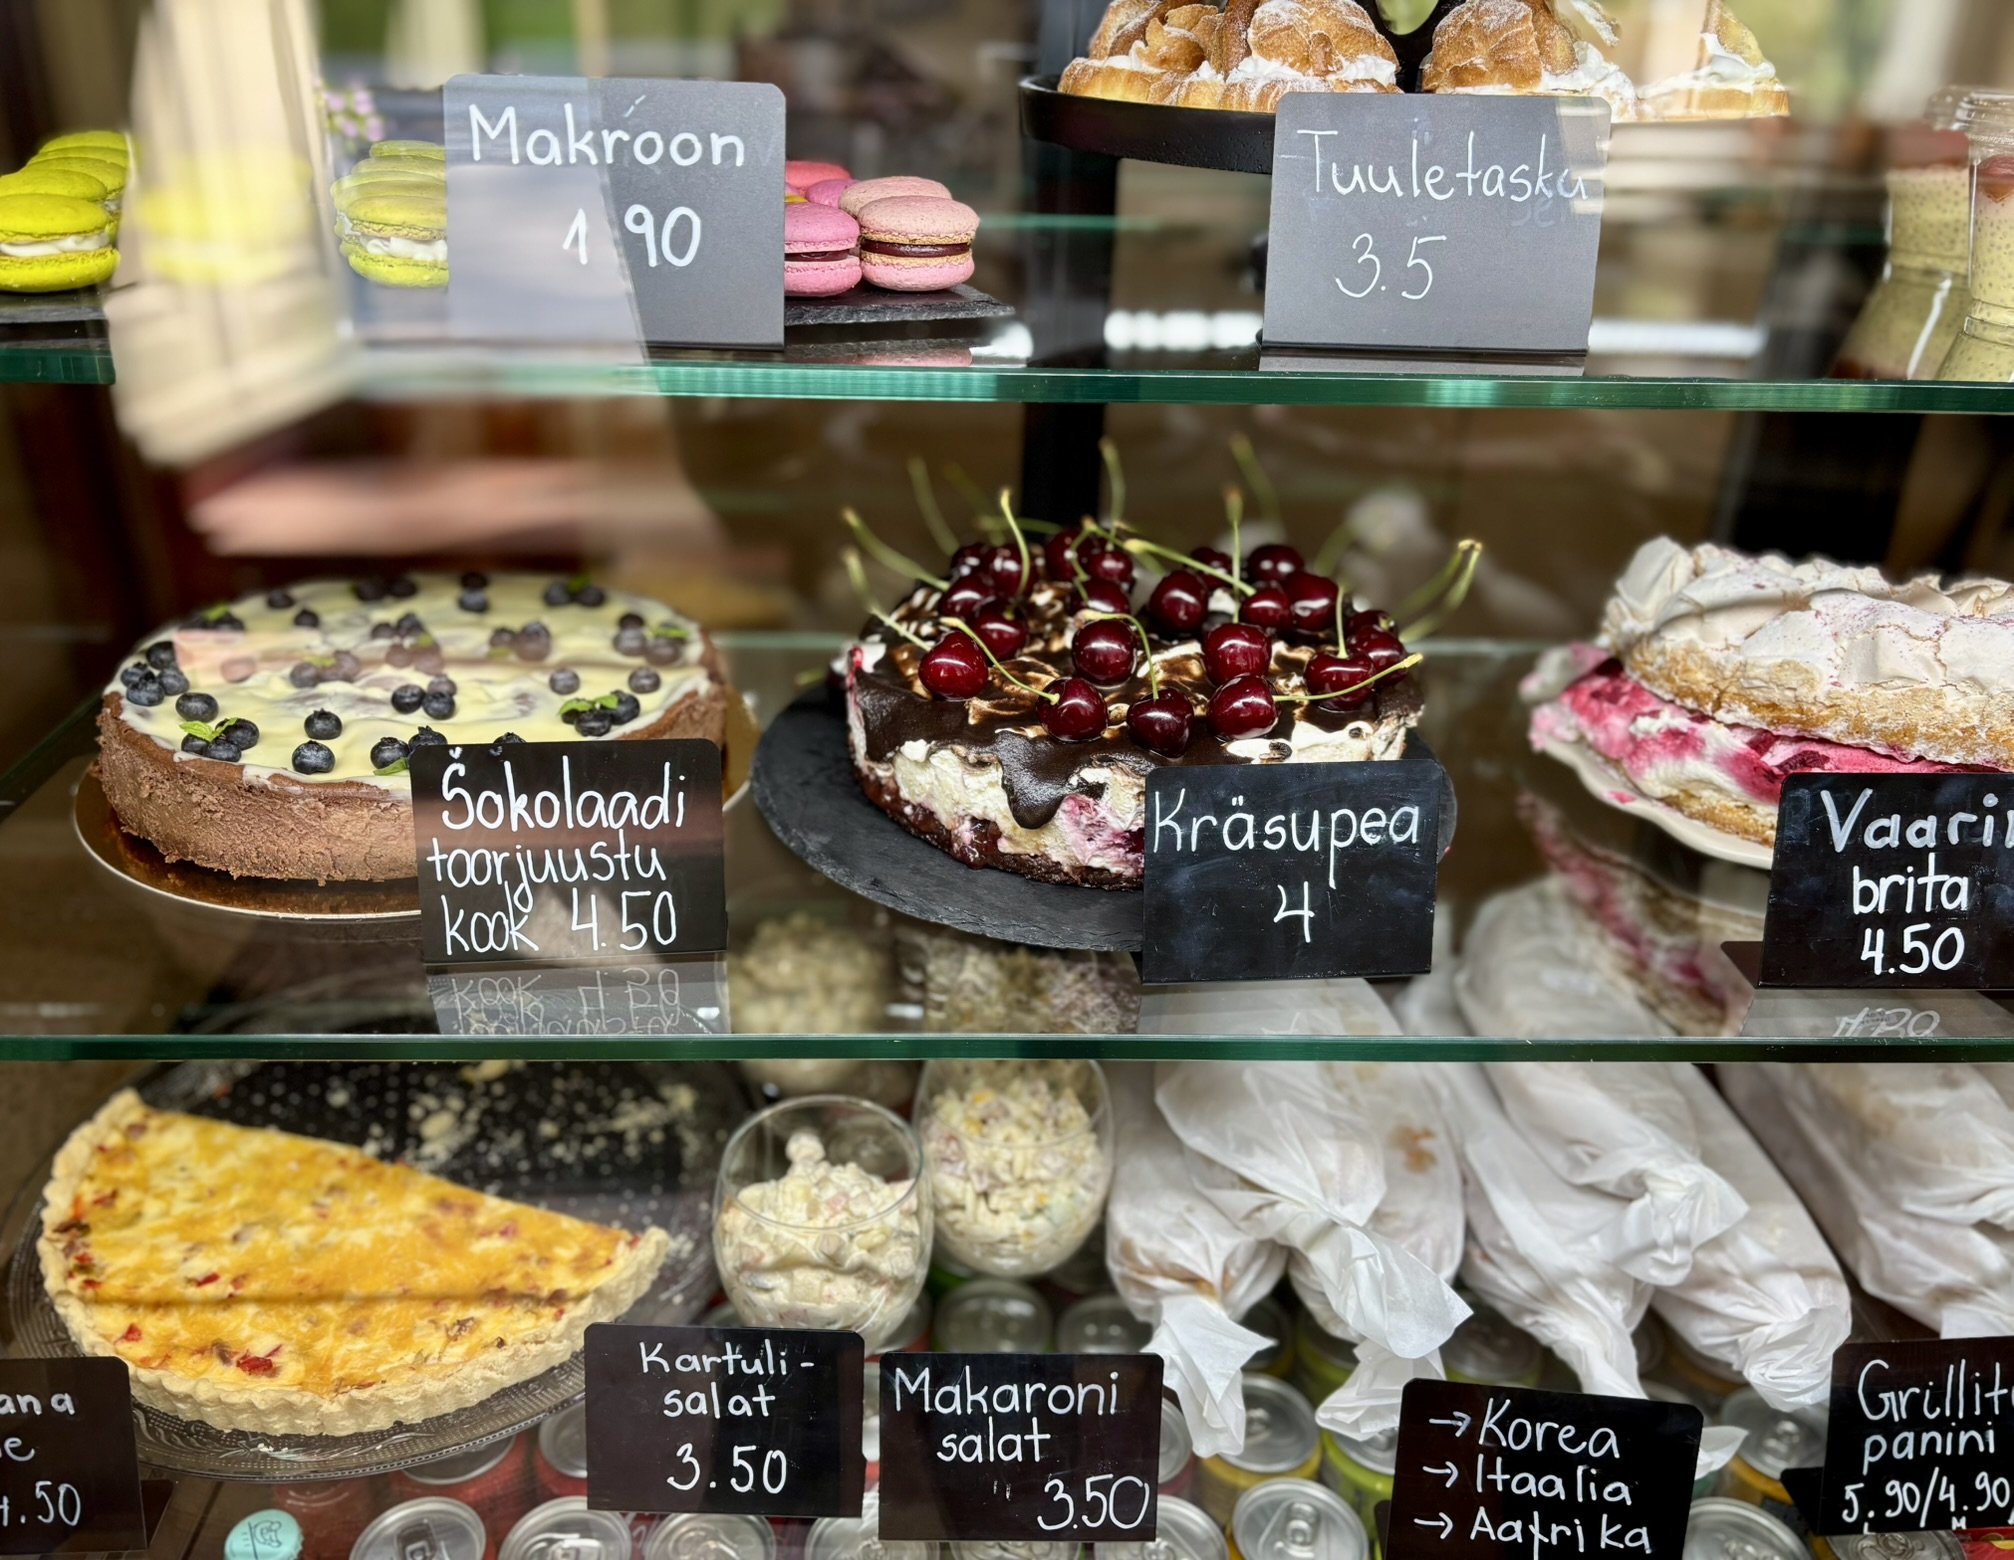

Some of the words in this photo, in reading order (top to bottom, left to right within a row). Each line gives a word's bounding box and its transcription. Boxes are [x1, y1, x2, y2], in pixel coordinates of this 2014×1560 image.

[1296, 129, 1590, 203] Tuuletasku
[561, 207, 589, 266] 1
[623, 203, 702, 268] 90
[1334, 232, 1448, 301] 3.5
[441, 746, 686, 832] Šokolaadi
[1820, 787, 2014, 853] Vaari
[1153, 787, 1420, 890] Kräsupea
[426, 829, 668, 913] toorjuustu
[1852, 851, 1969, 914] brita
[440, 881, 540, 956] kook
[570, 886, 678, 951] 4.50
[1273, 880, 1316, 943] 4
[1860, 922, 1966, 976] 4.50
[639, 1338, 815, 1376] Kartuli-
[663, 1381, 776, 1420] salat
[894, 1364, 1120, 1416] Makaroni
[1857, 1358, 2014, 1422] Grillit
[936, 1415, 1052, 1464] salat
[1477, 1397, 1621, 1459] Korea
[1862, 1420, 1996, 1477] panini
[666, 1442, 788, 1494] 3.50
[1475, 1452, 1633, 1506] Itaalia
[1036, 1472, 1150, 1531] 3.50
